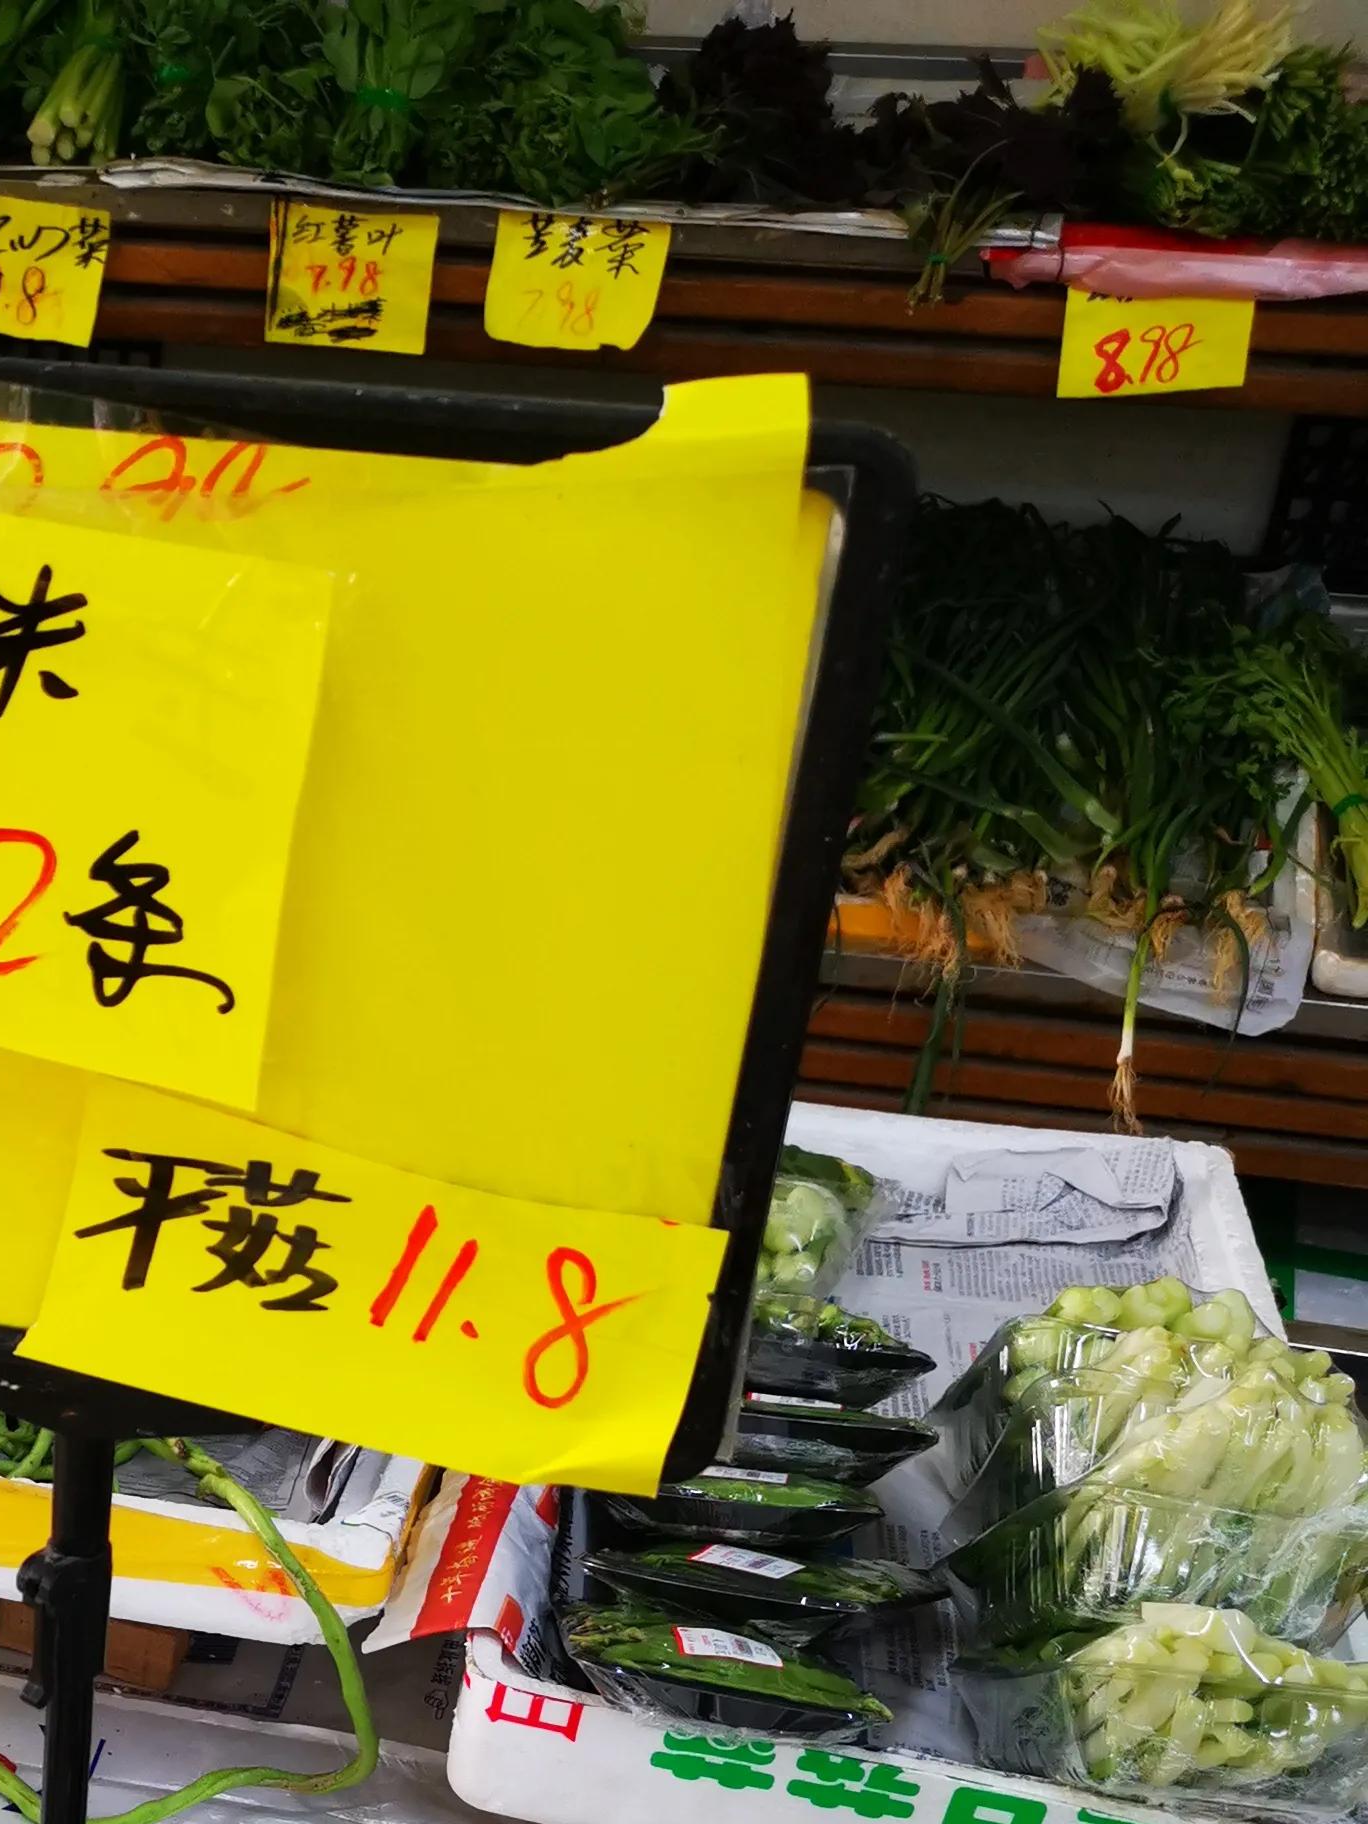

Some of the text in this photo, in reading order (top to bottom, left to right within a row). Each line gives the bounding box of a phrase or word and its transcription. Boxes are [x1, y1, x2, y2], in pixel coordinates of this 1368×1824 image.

[305, 256, 384, 297] 7.98
[1094, 322, 1204, 395] 8.98
[73, 1146, 353, 1313] 平菇
[368, 1203, 650, 1410] 11.8
